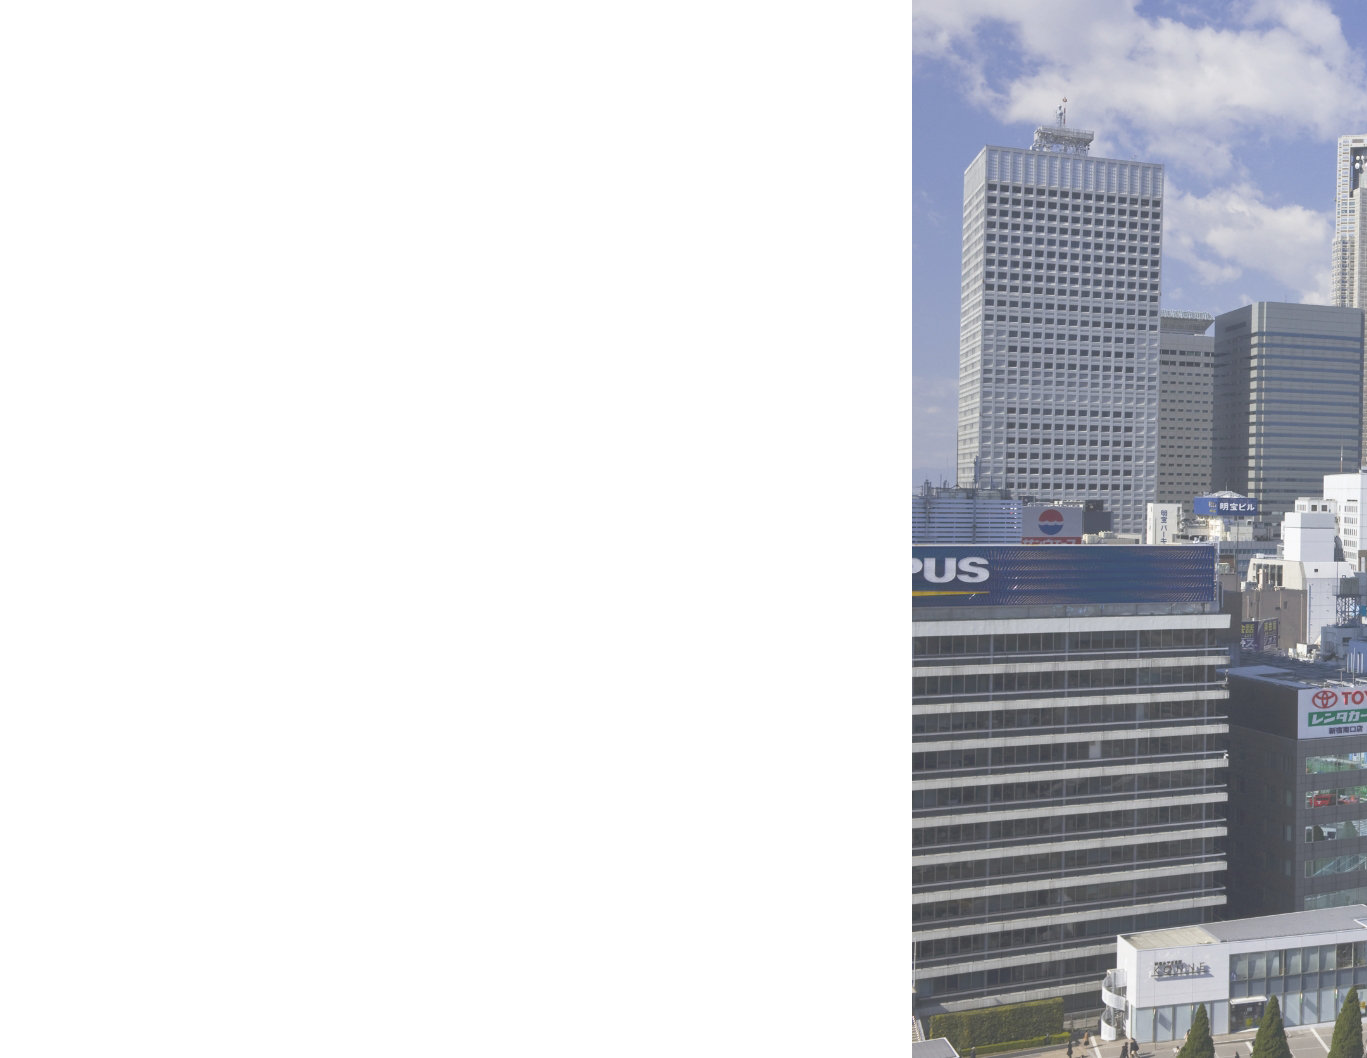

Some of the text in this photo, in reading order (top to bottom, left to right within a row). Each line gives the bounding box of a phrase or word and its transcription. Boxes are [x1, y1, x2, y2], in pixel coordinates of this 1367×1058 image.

[1219, 502, 1255, 511] 明宝ビル
[1154, 961, 1206, 975] KONNE
